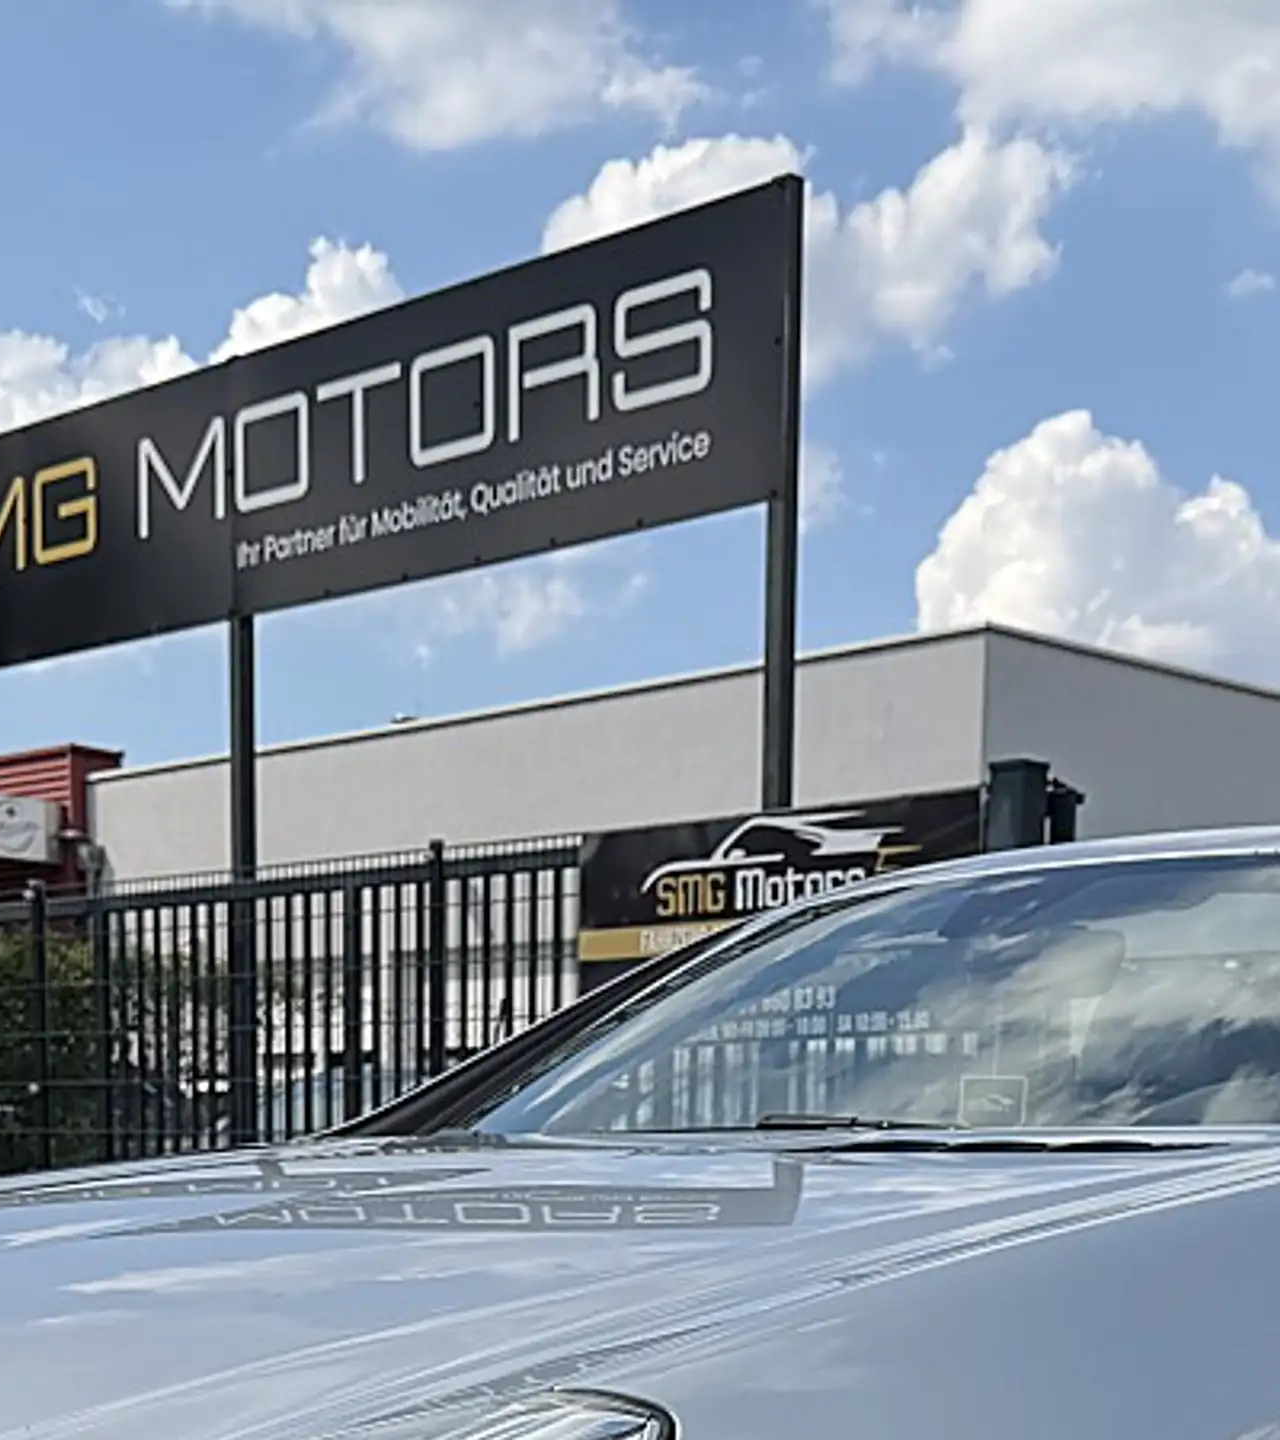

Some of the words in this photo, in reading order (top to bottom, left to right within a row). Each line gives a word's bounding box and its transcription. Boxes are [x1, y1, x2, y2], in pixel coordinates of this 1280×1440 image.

[137, 267, 713, 540] MOTORS
[236, 539, 262, 569] Ihr
[263, 525, 337, 564] Partner
[338, 514, 369, 547] für
[370, 489, 468, 539] Mobilität,
[470, 467, 560, 515] Qualität
[565, 453, 613, 490] und
[618, 430, 711, 477] Service
[655, 871, 728, 917] SMG
